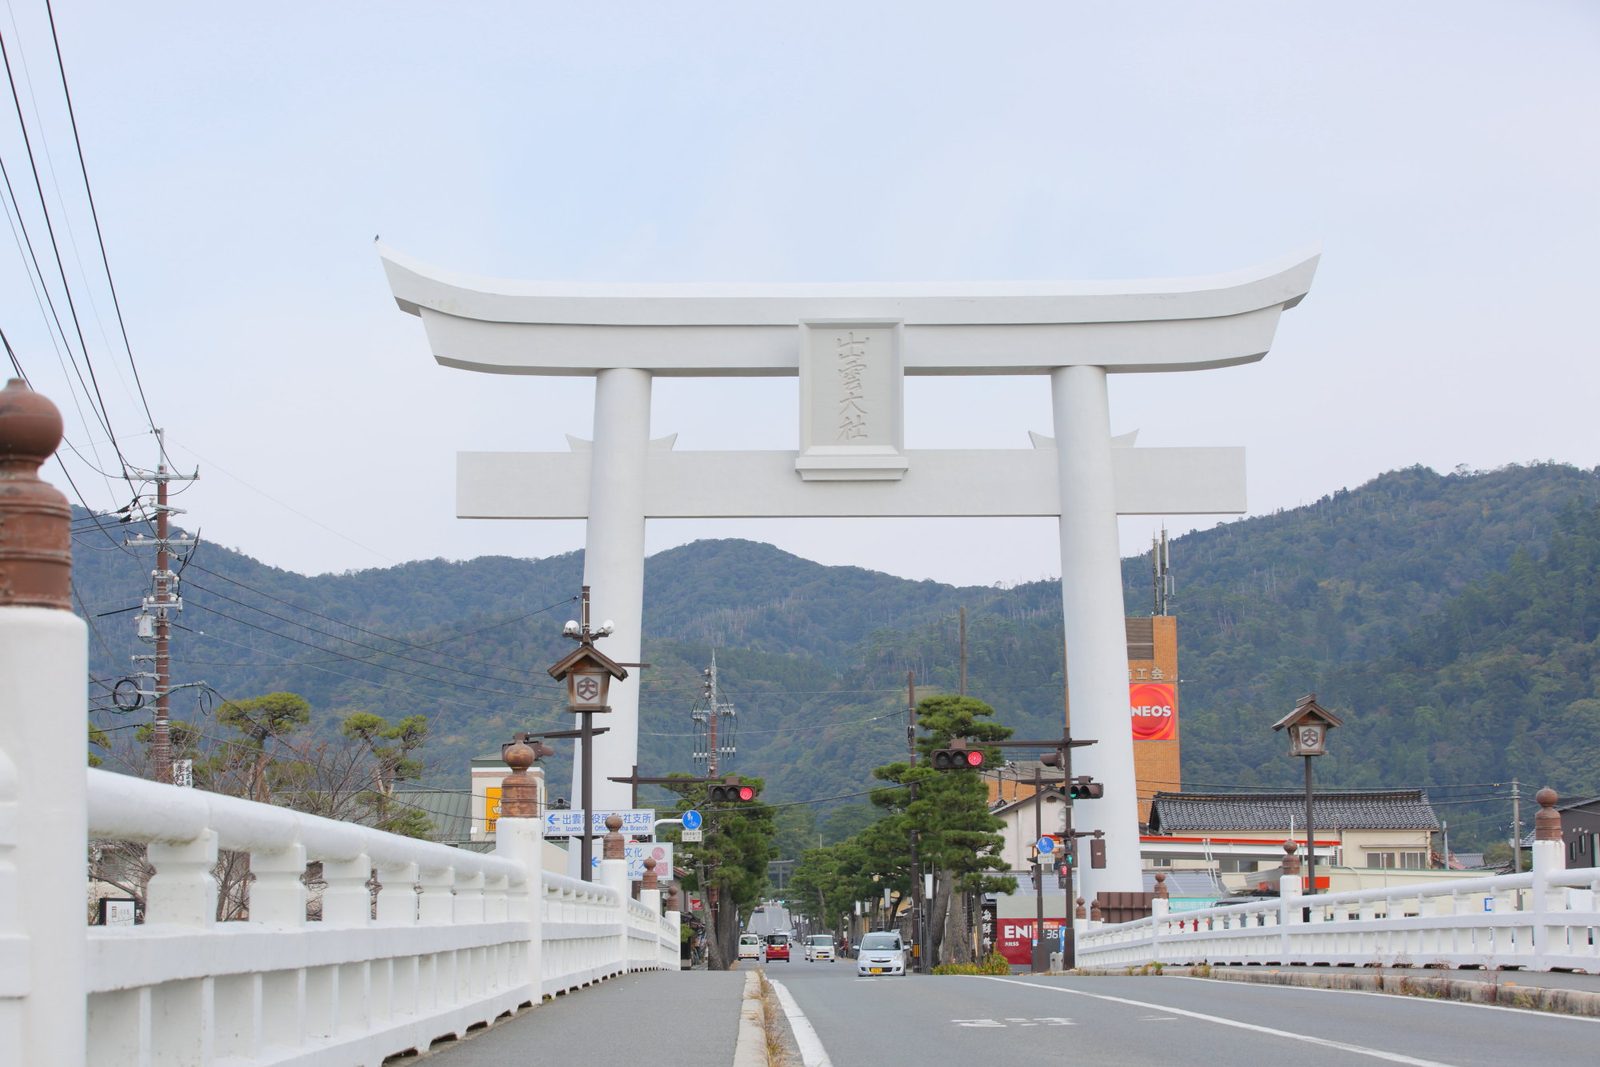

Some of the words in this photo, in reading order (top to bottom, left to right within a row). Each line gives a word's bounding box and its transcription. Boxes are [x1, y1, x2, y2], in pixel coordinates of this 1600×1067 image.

[836, 331, 870, 441] 出雲大社
[1131, 705, 1172, 717] NEOS
